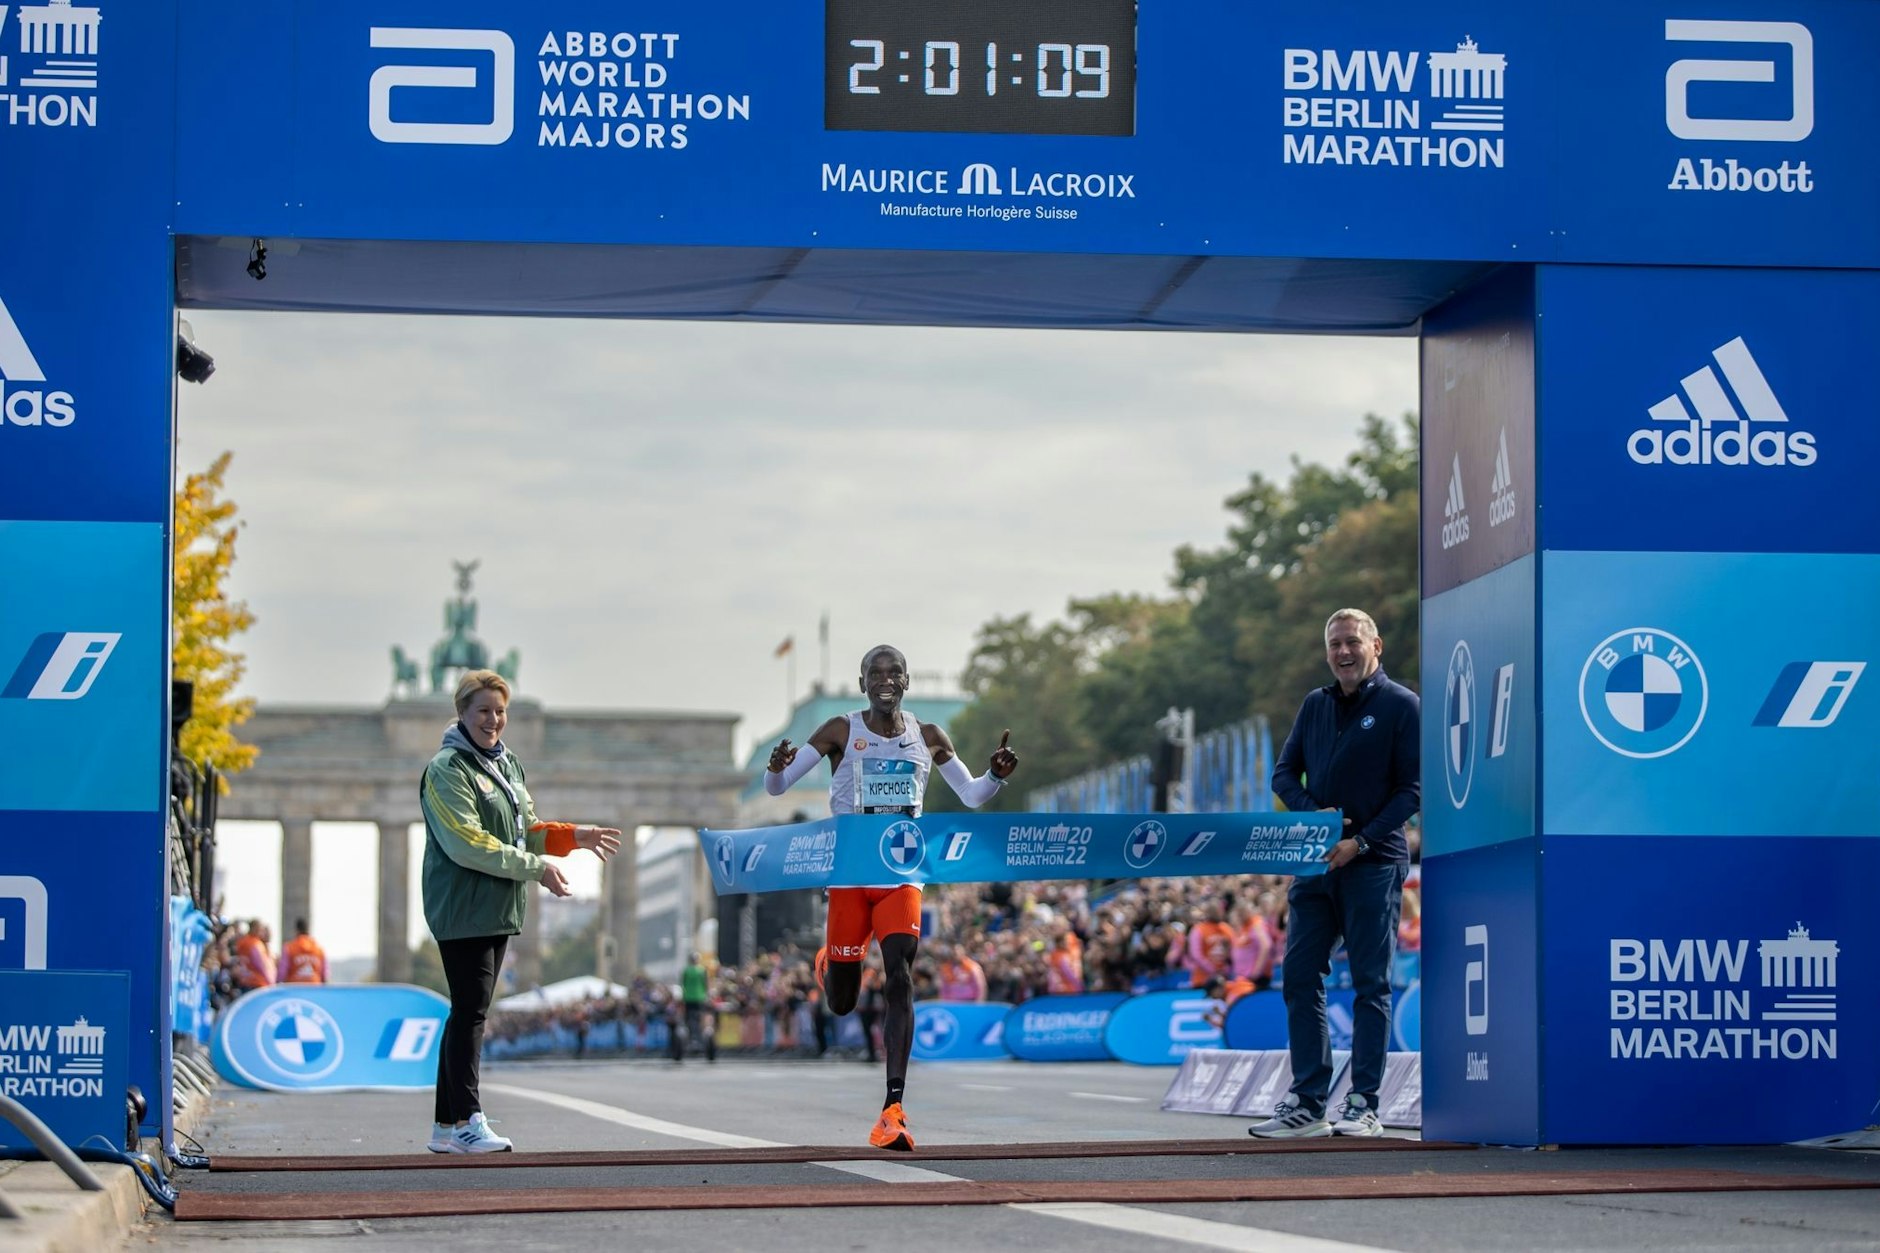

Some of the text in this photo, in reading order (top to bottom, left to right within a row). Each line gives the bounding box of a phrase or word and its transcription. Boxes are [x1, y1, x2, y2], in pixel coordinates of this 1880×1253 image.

[538, 31, 680, 59] ABBOTT
[538, 60, 667, 88] WORLD
[849, 39, 1111, 98] 2:01:09
[1284, 48, 1420, 93] BMW
[538, 90, 751, 121] MARATHON
[1283, 97, 1420, 130] BERLIN
[538, 121, 688, 150] MAJORS
[1283, 133, 1504, 168] MARATHON
[822, 163, 1136, 198] MAURICE LACROIX
[1667, 158, 1814, 193] Abbott
[880, 202, 1078, 222] Manufacture Horlogère Suisse
[1626, 420, 1818, 467] adidas
[1488, 486, 1516, 527] adidas
[1442, 510, 1470, 550] adidas
[1596, 634, 1691, 670] BMW
[869, 782, 911, 795] KIPCHOGE
[789, 830, 837, 852] BMW 20
[1008, 826, 1093, 845] BMW 20
[1250, 825, 1330, 844] BMW 20
[785, 851, 835, 871] BERLIN 22
[1006, 842, 1088, 865] BERLIN 22
[1006, 854, 1064, 866] MARATHON
[1241, 850, 1301, 863] MARATHON
[1245, 840, 1328, 863] BERLIN 22
[783, 861, 824, 875] MARATHON
[830, 945, 865, 956] INEOS
[1610, 938, 1750, 983] BMW
[1610, 989, 1750, 1021] BERLIN
[1610, 1027, 1838, 1060] MARATHON
[1466, 1052, 1489, 1081] Abbott
[0, 1077, 103, 1097] RATHON
